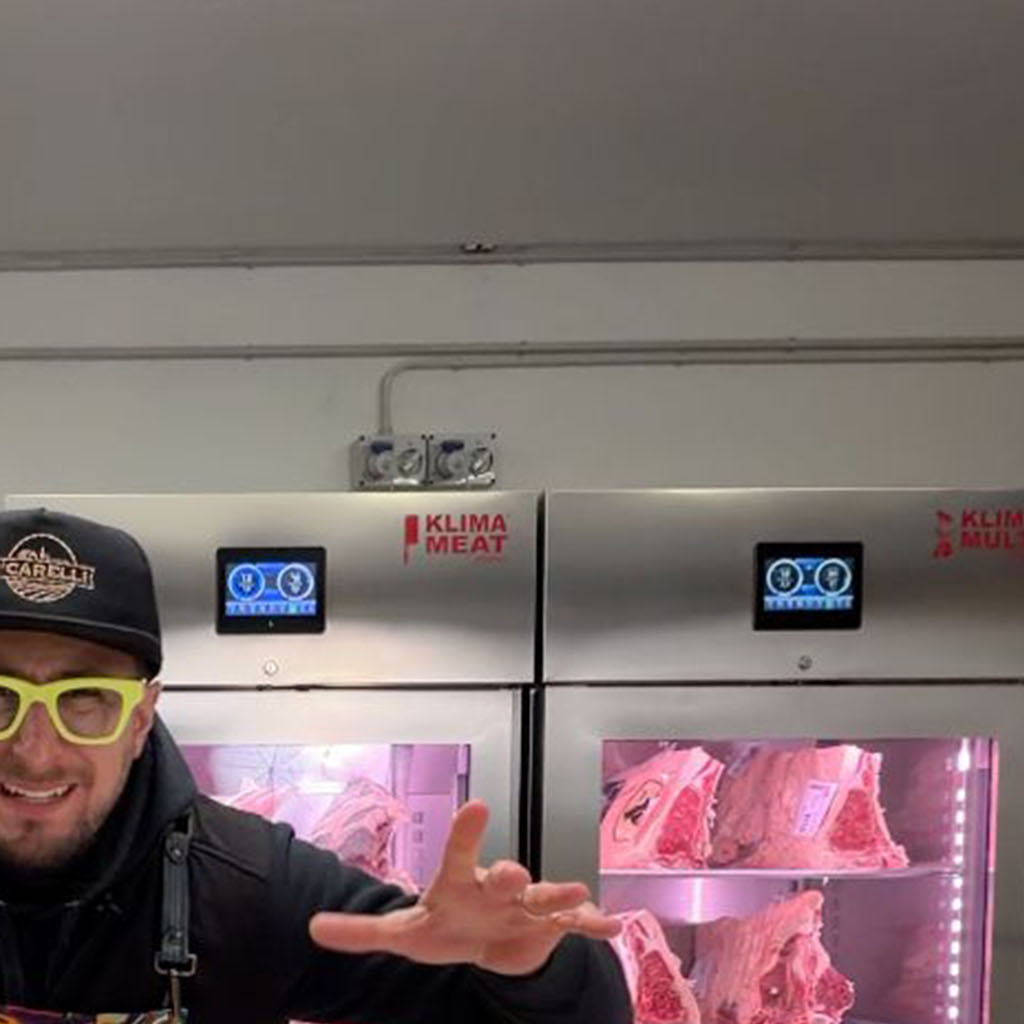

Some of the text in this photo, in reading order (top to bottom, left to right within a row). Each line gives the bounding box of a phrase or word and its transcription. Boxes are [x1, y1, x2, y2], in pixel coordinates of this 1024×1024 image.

[426, 513, 507, 532] KLIMA
[426, 535, 508, 553] MEAT
[6, 562, 88, 584] CARELLI
